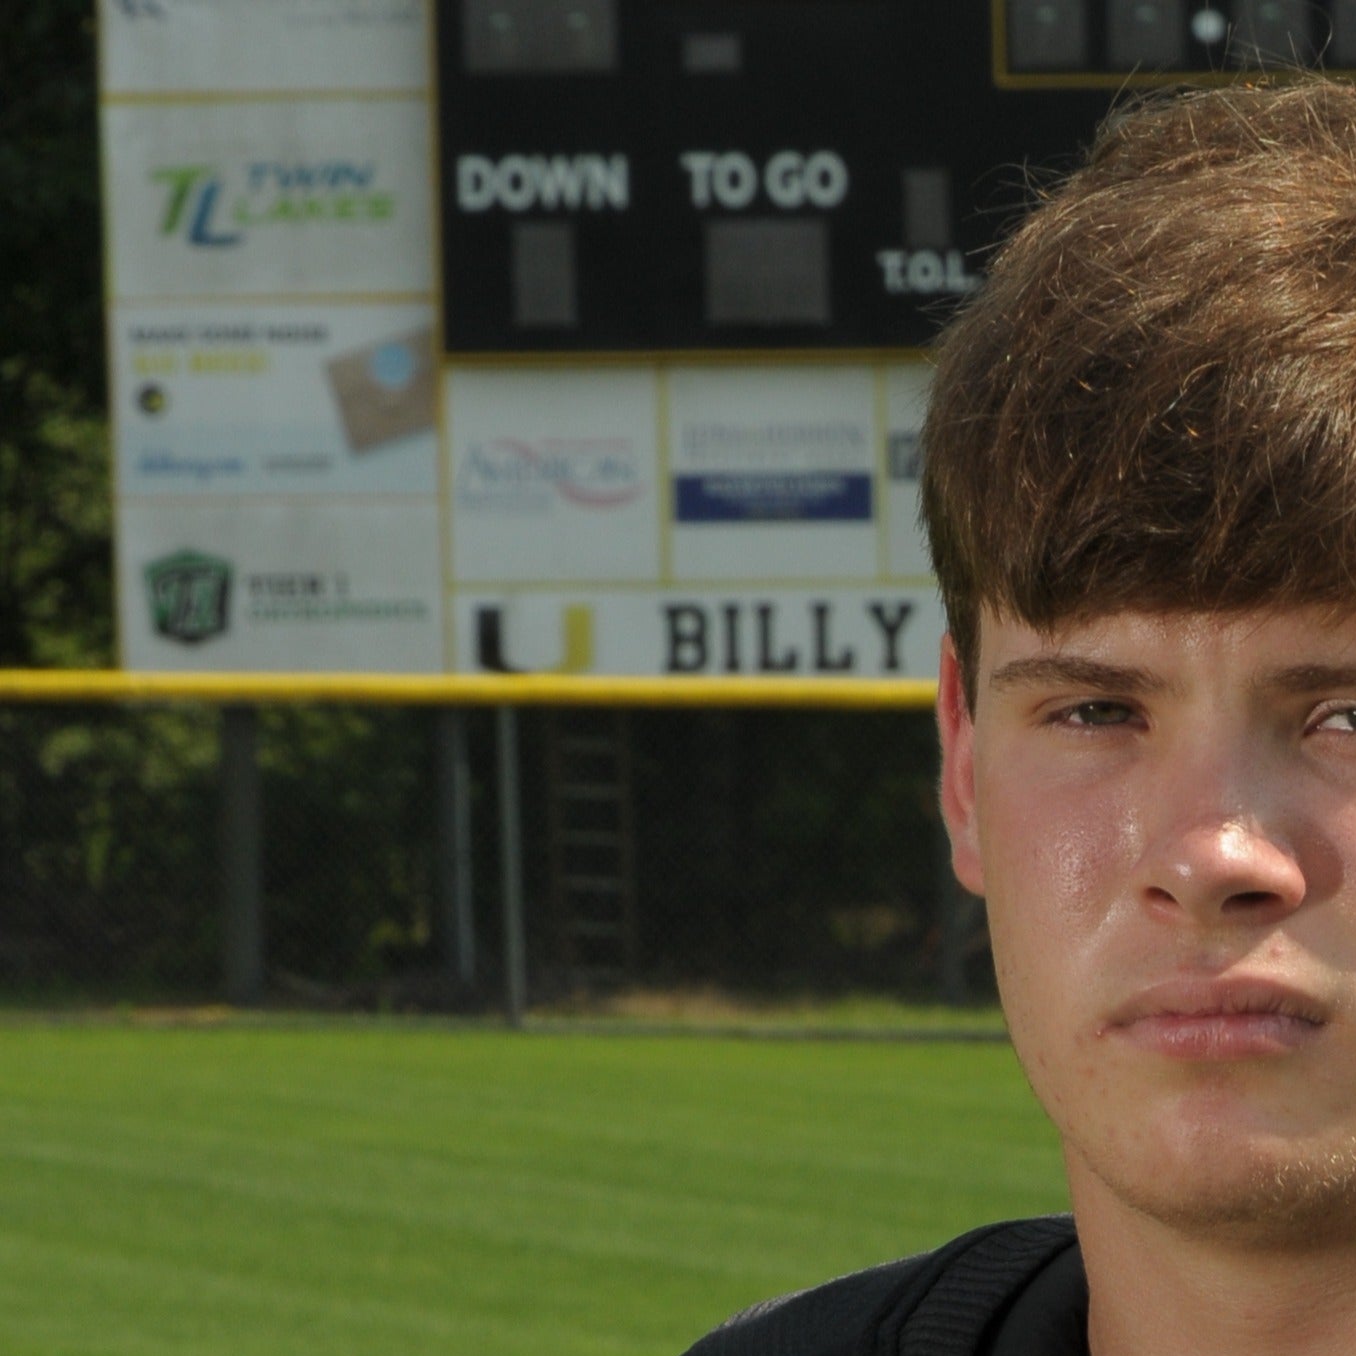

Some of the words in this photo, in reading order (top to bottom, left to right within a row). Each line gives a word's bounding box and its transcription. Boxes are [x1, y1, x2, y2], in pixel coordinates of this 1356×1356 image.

[246, 161, 375, 189] TWIN
[456, 152, 630, 212] DOWN
[680, 151, 757, 208] TO
[765, 150, 848, 208] GO
[233, 193, 396, 224] LAKES
[663, 603, 914, 673] BILLY
